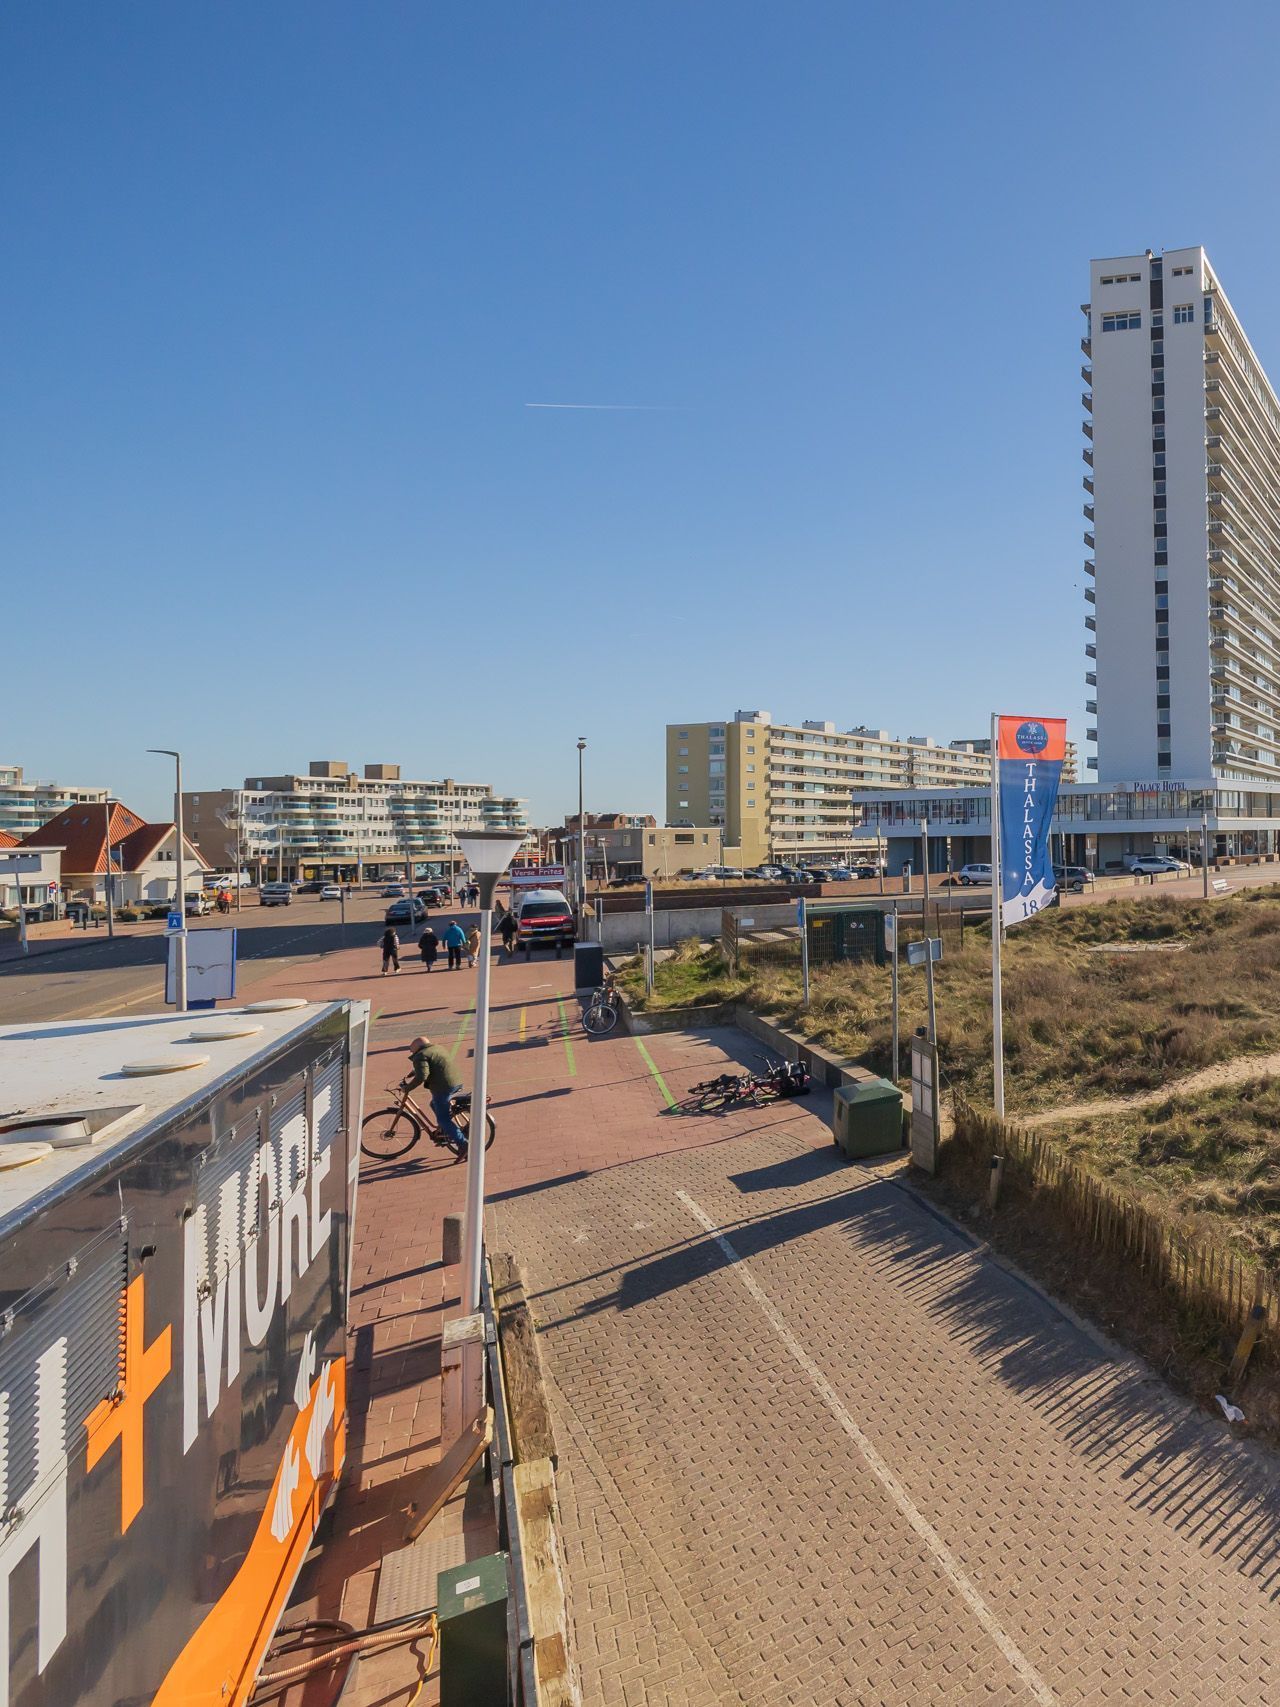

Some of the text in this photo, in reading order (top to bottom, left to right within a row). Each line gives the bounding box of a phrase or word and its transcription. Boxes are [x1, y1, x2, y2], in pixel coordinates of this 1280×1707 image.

[1023, 762, 1037, 886] THALASSA
[1163, 781, 1186, 791] HOTEL
[184, 1084, 332, 1456] MORE
